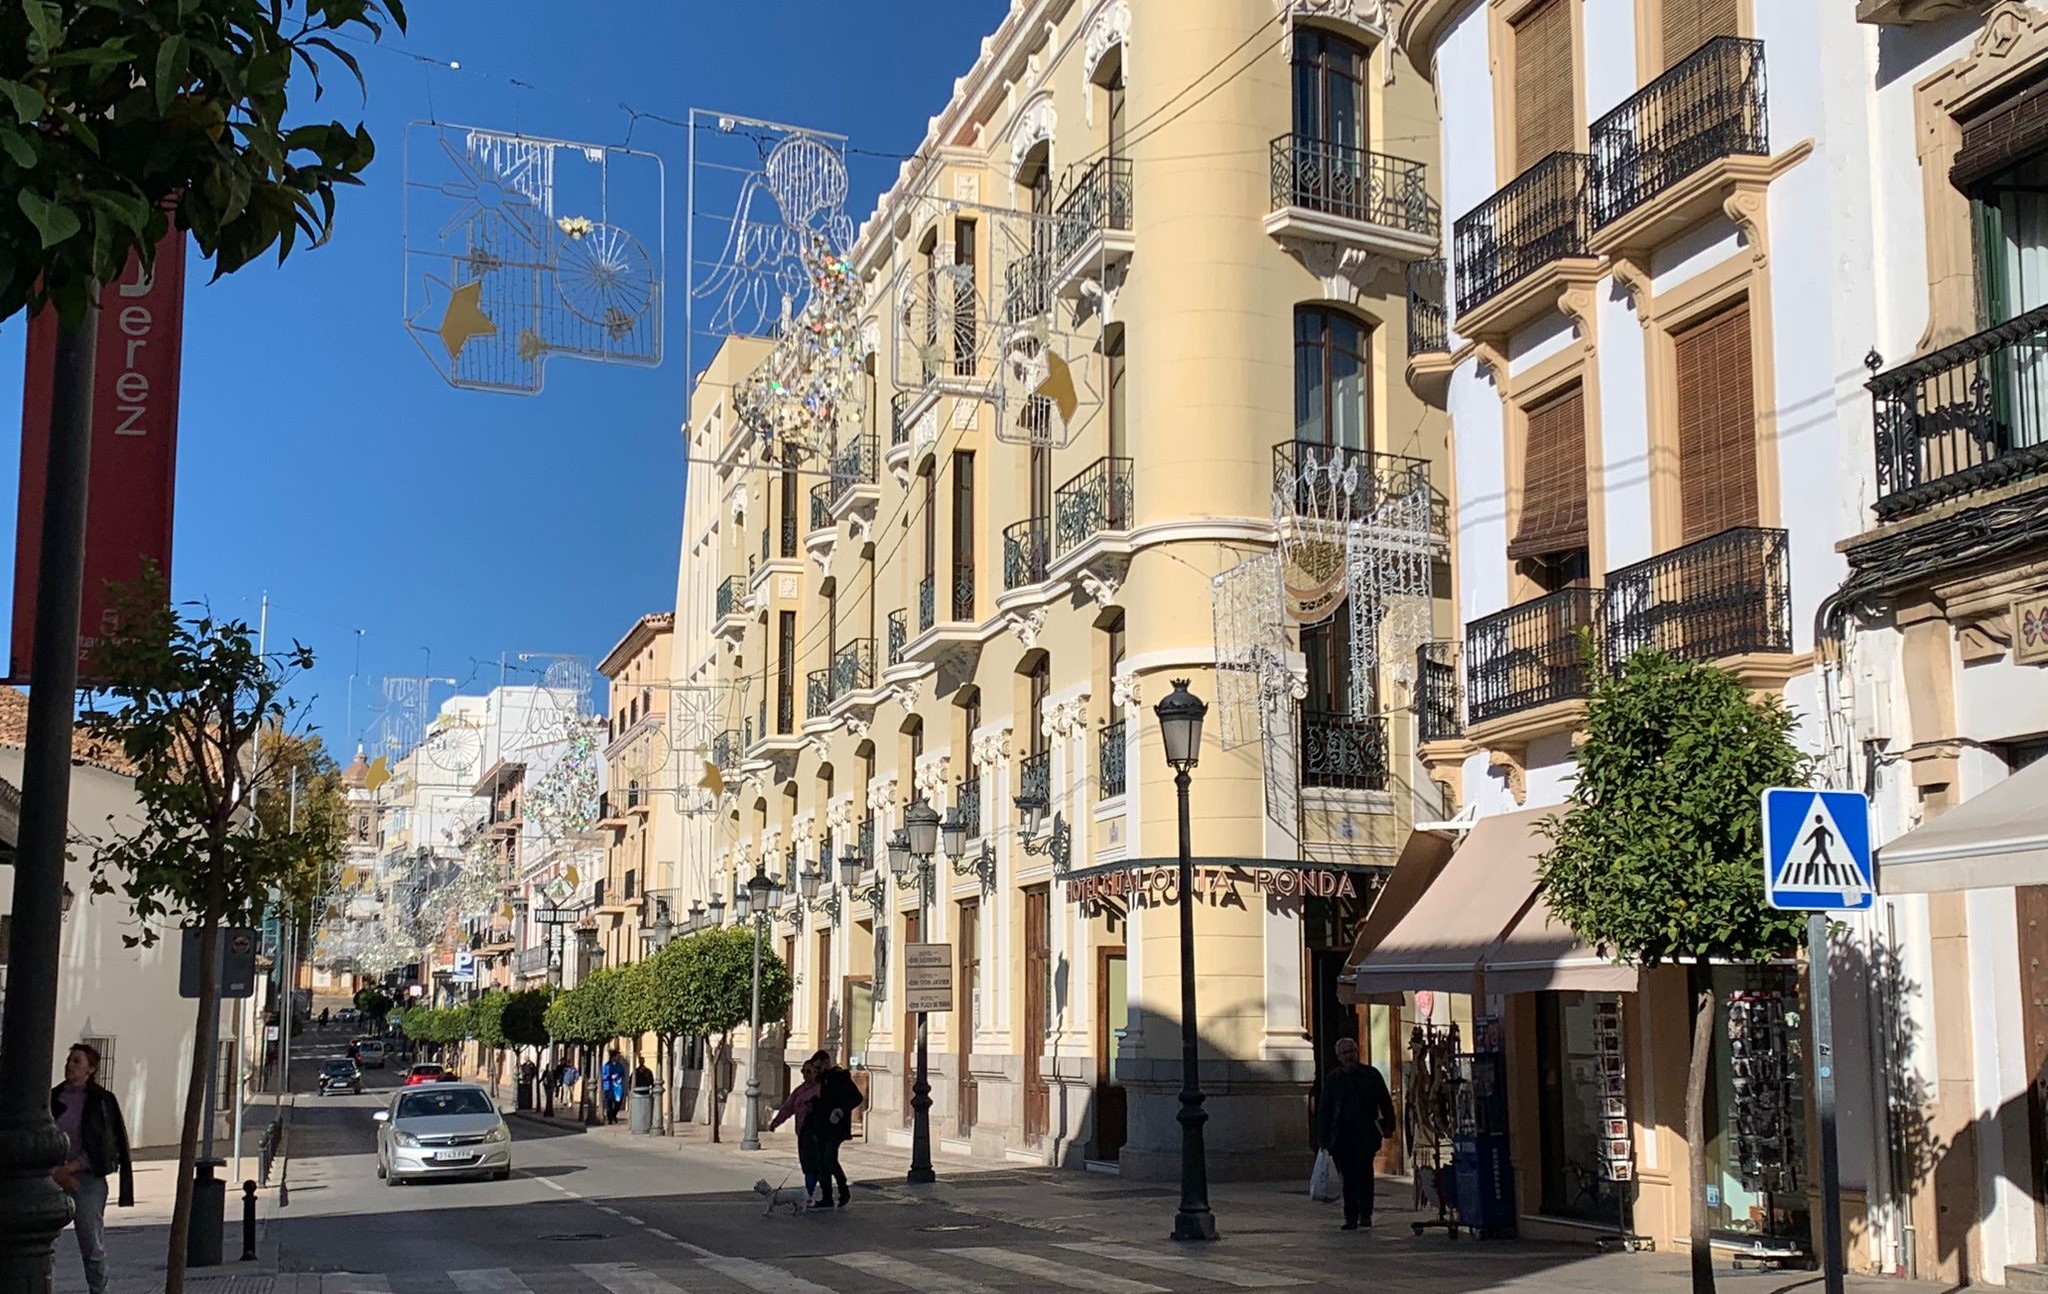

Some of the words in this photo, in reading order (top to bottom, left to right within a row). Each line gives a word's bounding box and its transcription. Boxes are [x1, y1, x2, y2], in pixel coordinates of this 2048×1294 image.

[1066, 873, 1099, 904] HOTEL
[1103, 865, 1233, 897] CTALONIA
[1254, 868, 1357, 899] RONDA
